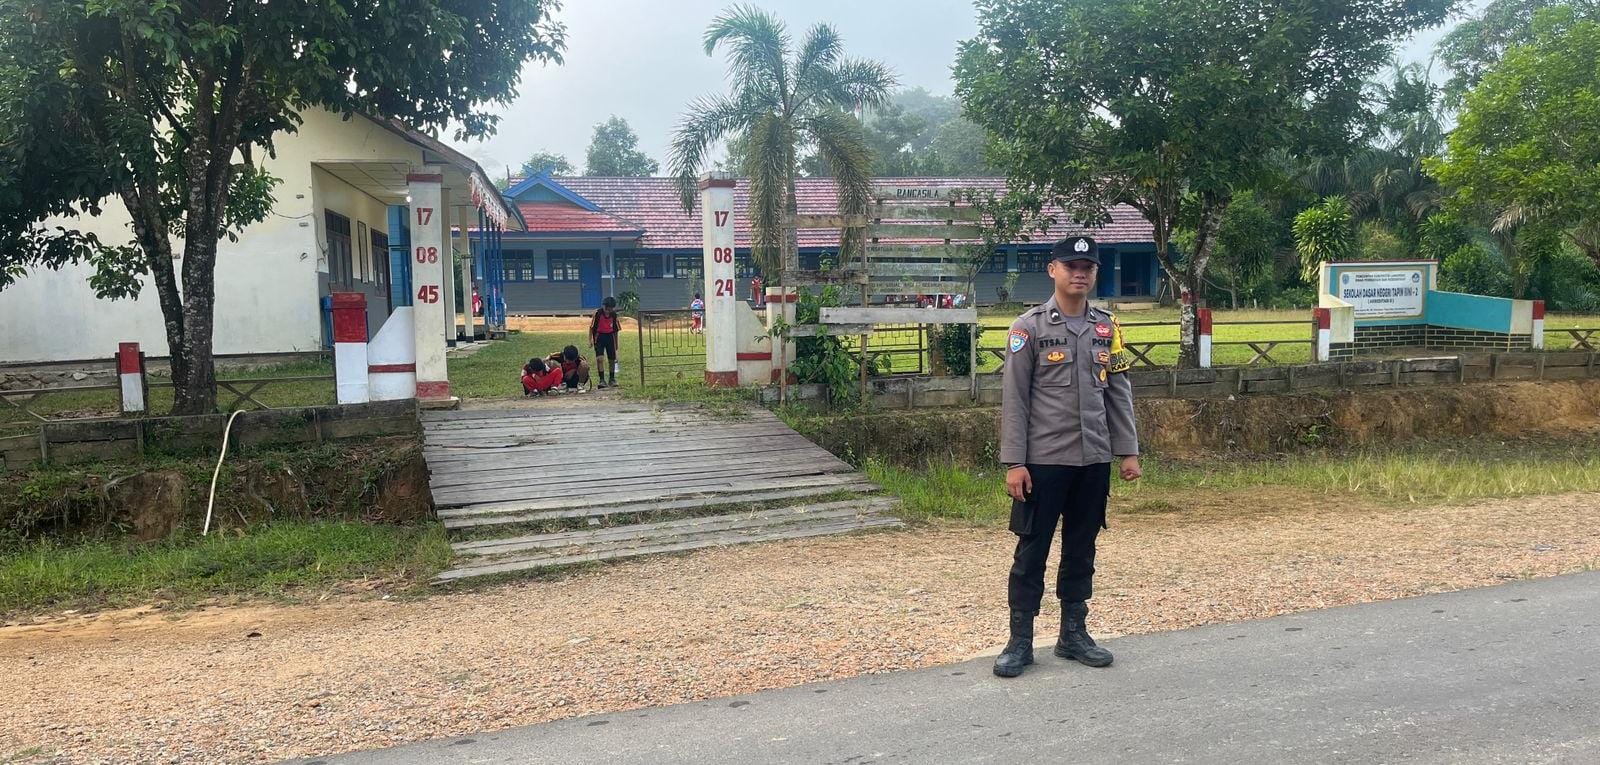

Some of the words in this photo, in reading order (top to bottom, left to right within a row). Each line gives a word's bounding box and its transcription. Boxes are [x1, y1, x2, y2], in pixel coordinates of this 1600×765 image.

[897, 188, 939, 198] PANCASILA
[416, 207, 433, 226] 17
[714, 210, 729, 227] 17
[416, 246, 438, 264] 08
[713, 247, 732, 264] 08
[417, 285, 439, 304] 45
[715, 279, 733, 297] 24
[1343, 288, 1362, 299] SEKOLAH
[1362, 288, 1376, 298] DASAR
[1377, 287, 1391, 298] NEGERI
[1415, 287, 1419, 297] 2
